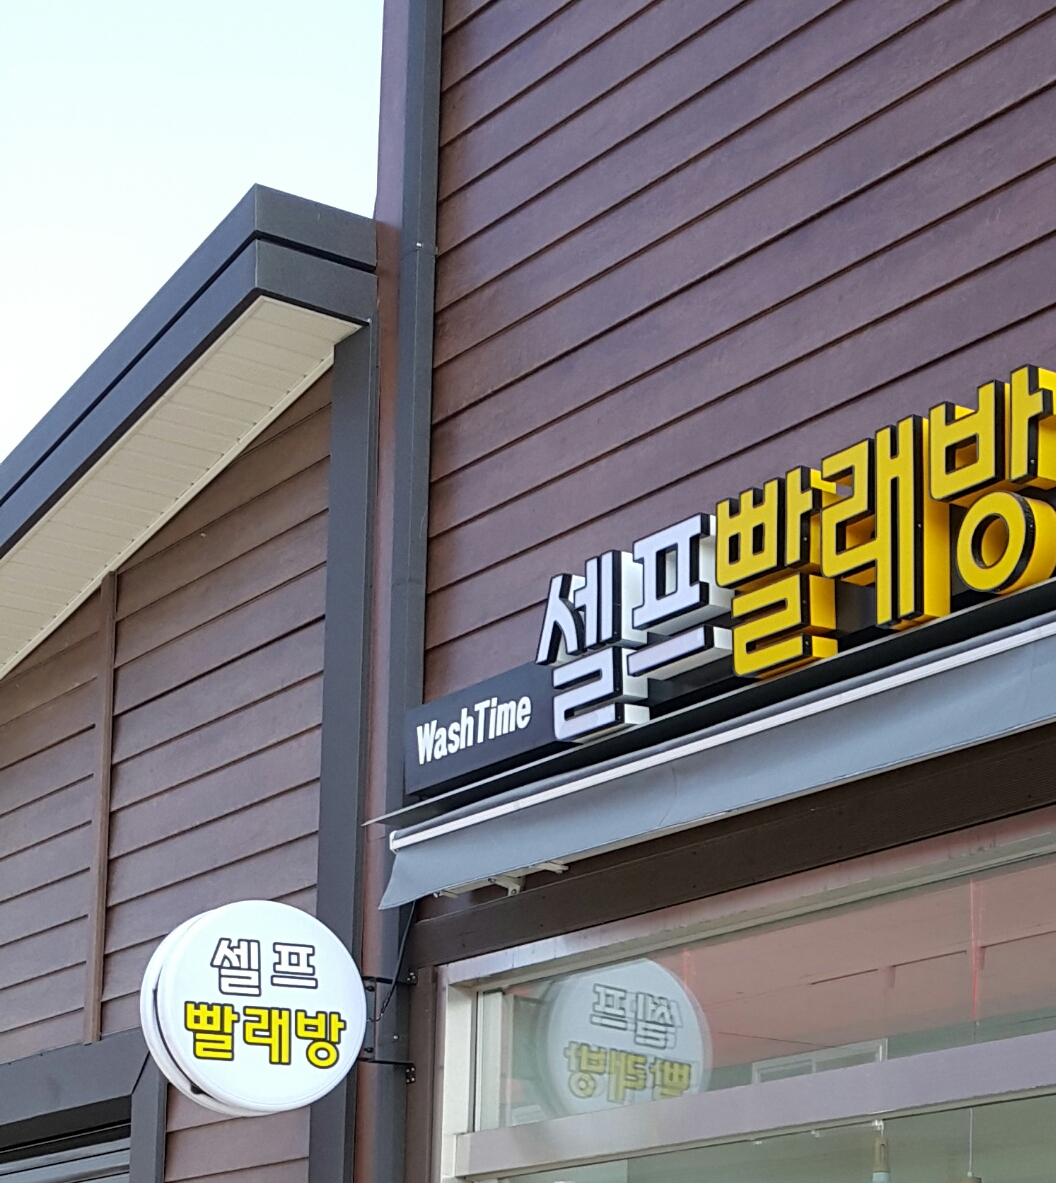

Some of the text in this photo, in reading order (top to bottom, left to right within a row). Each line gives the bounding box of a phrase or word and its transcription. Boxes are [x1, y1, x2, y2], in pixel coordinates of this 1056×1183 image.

[416, 692, 532, 766] WashTime
[209, 937, 320, 998] 셀프
[183, 1001, 348, 1070] 빨래방
